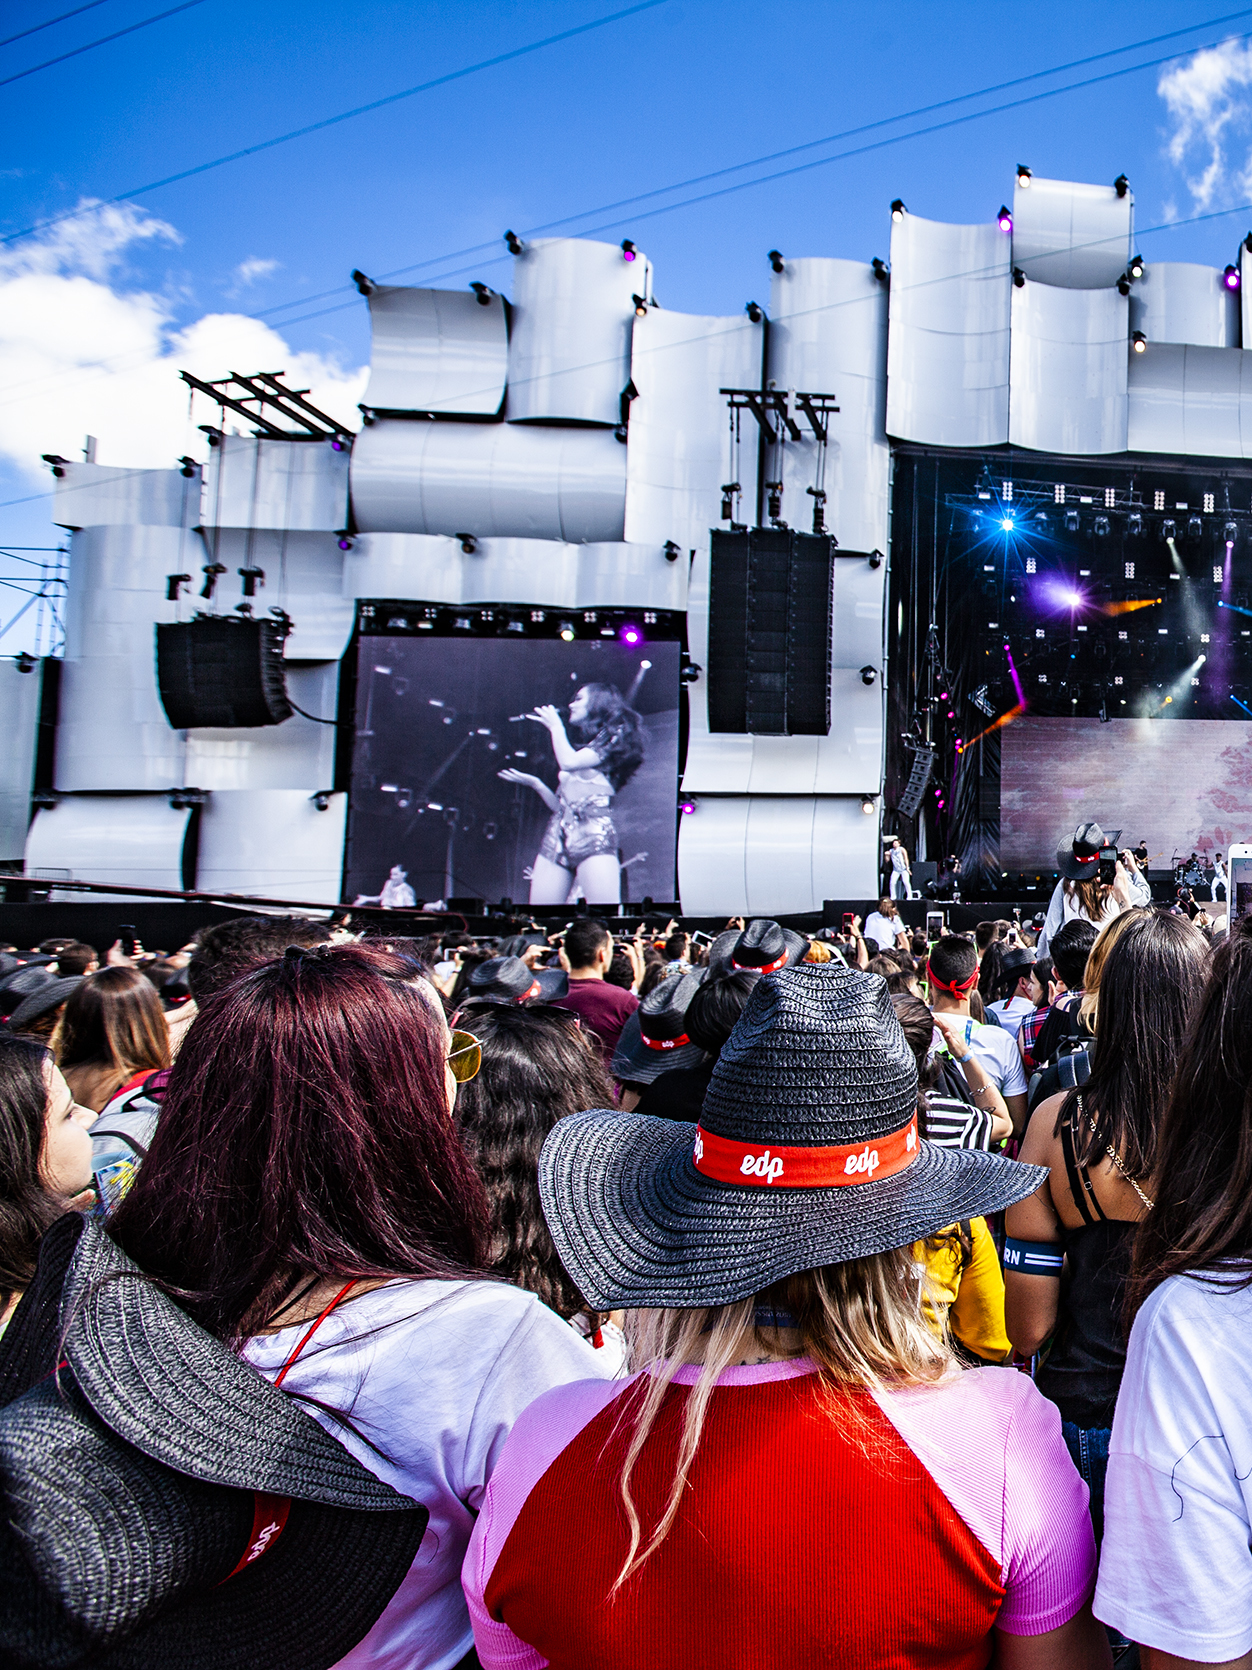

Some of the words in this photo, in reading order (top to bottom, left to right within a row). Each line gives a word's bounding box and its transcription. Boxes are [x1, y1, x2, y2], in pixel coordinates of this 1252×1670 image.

[740, 1150, 784, 1184] edp
[844, 1146, 880, 1177] edp
[246, 1521, 280, 1562] edp
